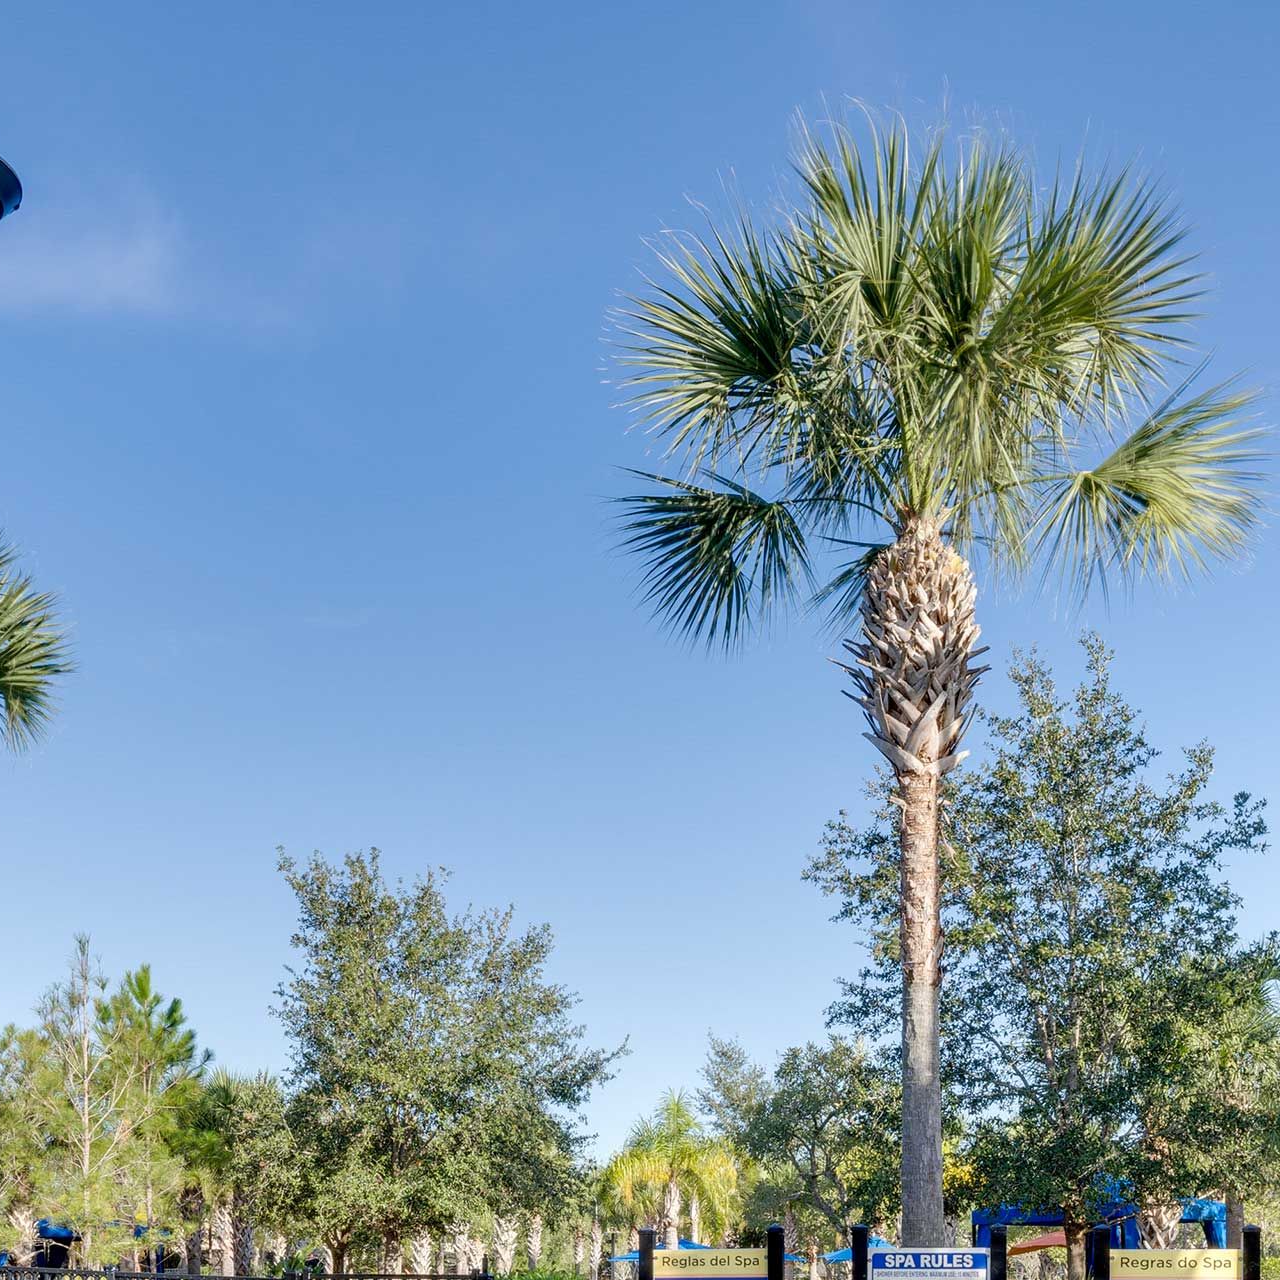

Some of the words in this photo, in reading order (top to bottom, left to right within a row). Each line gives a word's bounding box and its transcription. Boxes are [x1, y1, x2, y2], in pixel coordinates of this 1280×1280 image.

[662, 1256, 706, 1268] Reglas
[710, 1256, 730, 1266] del
[735, 1256, 759, 1268] Spa
[885, 1254, 916, 1268] SPA
[920, 1254, 973, 1268] RULES
[1120, 1257, 1172, 1270] Regras
[1178, 1257, 1197, 1268] do
[1203, 1257, 1232, 1270] Spa
